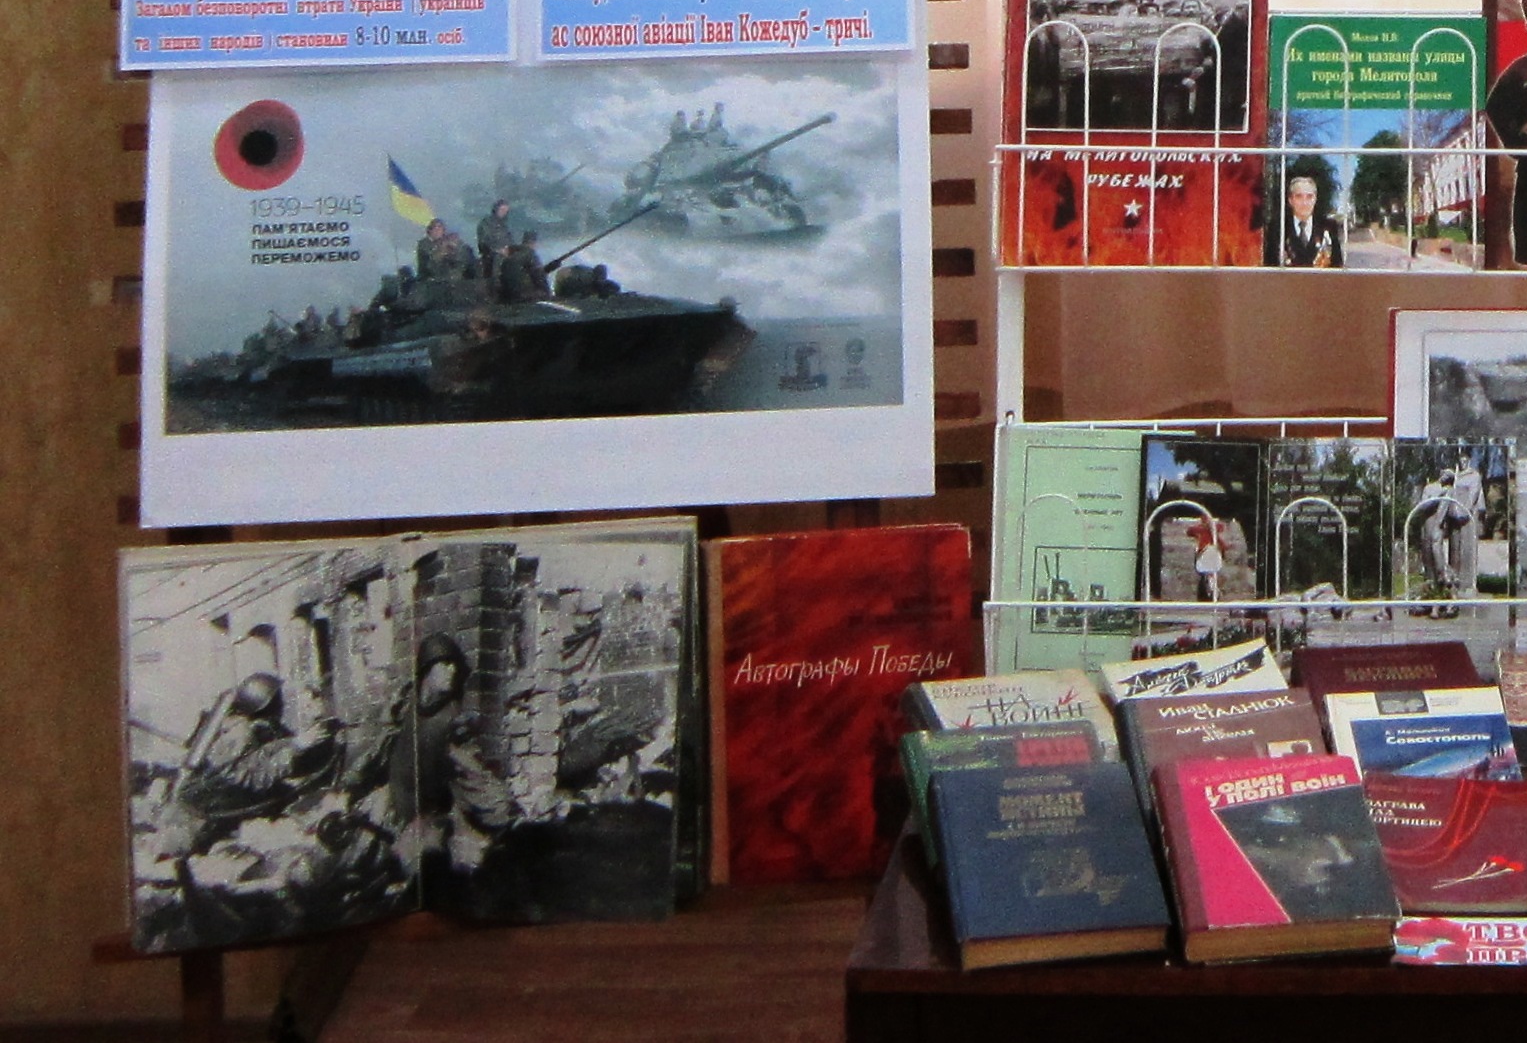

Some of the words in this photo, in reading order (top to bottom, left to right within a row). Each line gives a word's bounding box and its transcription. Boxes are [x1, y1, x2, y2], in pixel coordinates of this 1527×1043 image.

[355, 27, 390, 45] 8-10
[252, 236, 350, 249] ПИШАЄМОСЯ
[252, 250, 360, 264] ПЕРЕМОЖЕМО
[735, 653, 859, 687] Автографы
[869, 645, 952, 676] Победы
